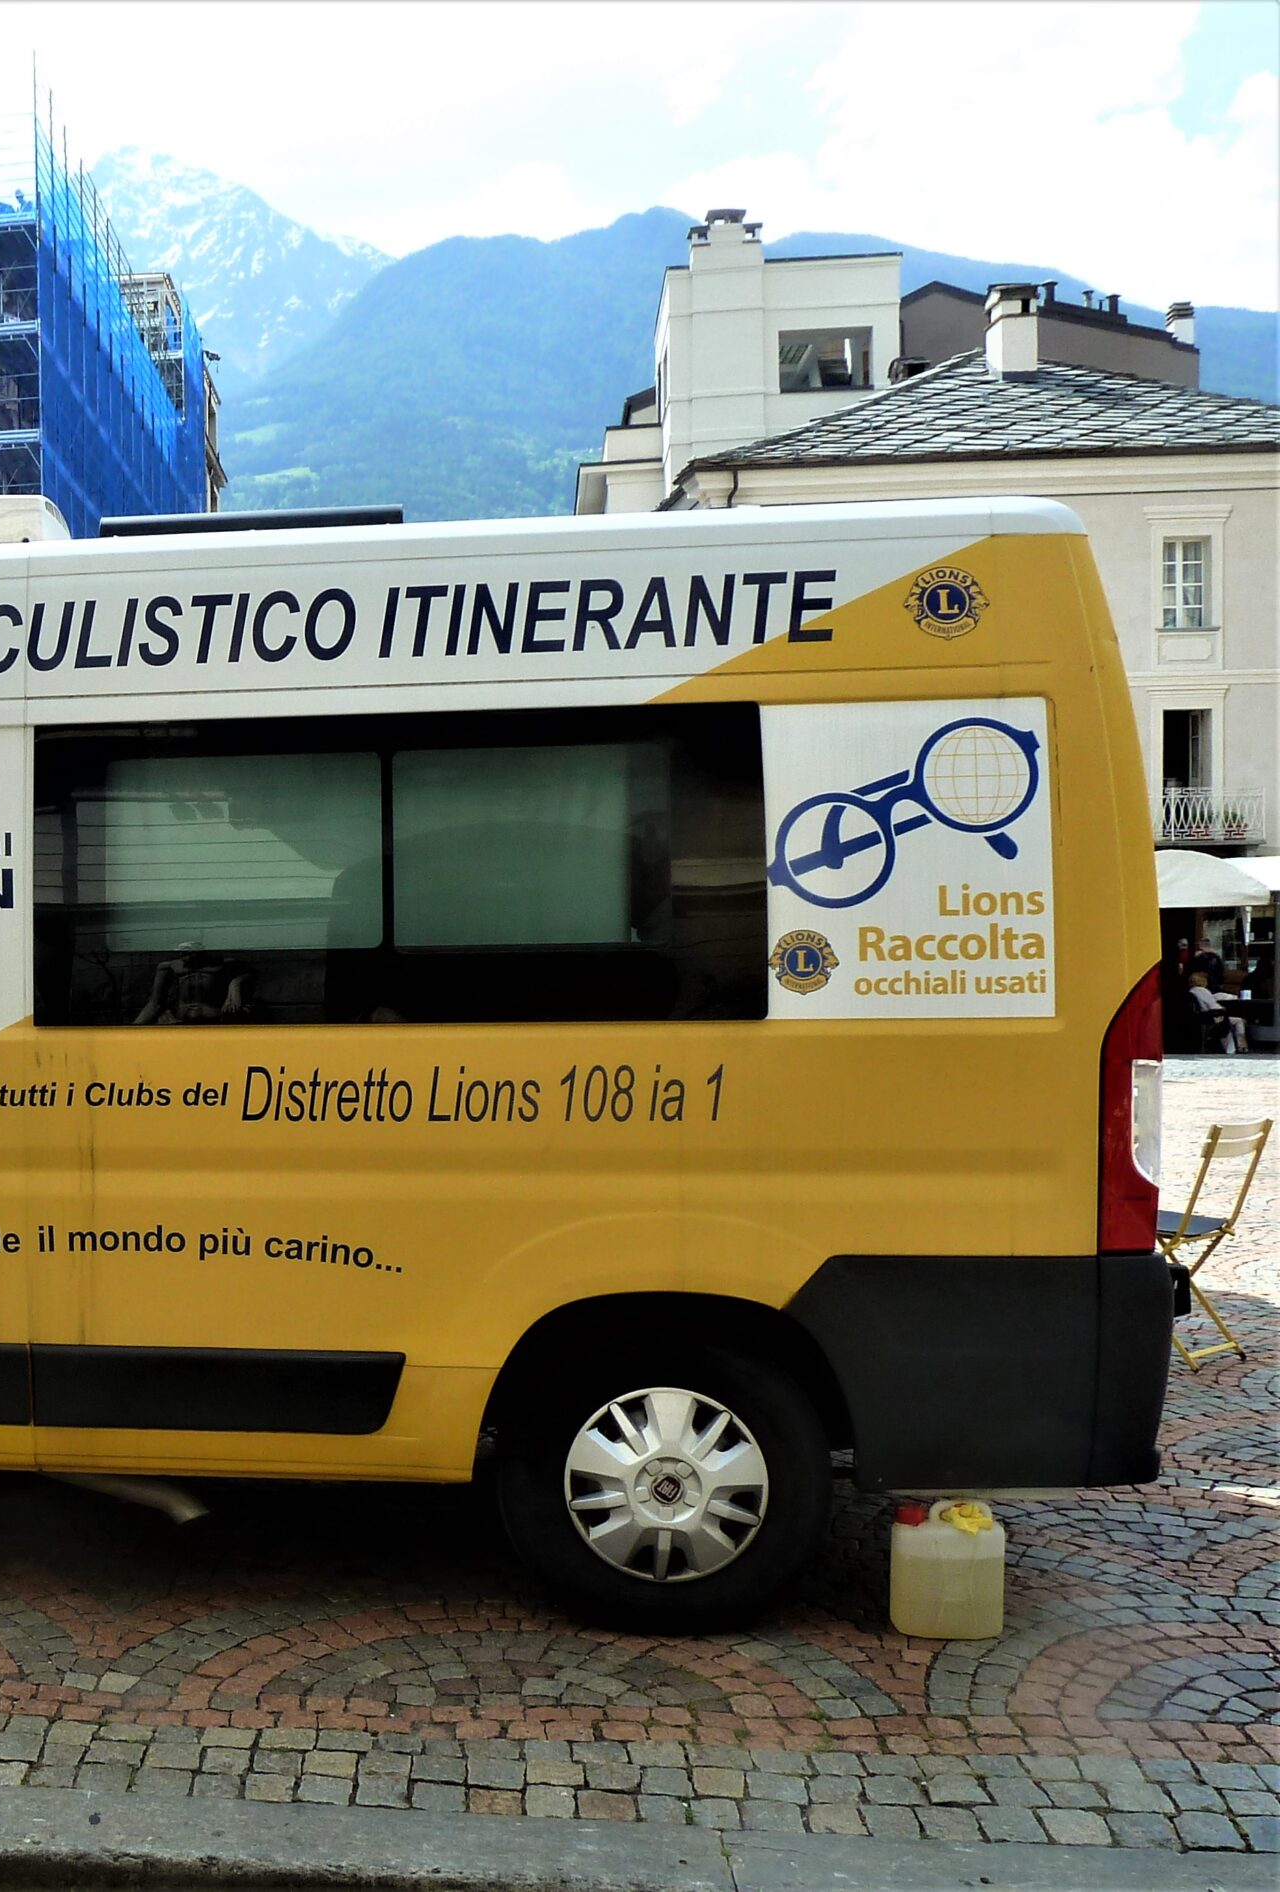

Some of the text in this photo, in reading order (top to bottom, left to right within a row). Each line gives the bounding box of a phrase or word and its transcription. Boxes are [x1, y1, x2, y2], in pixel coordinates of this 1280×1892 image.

[921, 569, 970, 585] LIONS
[378, 569, 837, 659] ITINERANTE
[937, 589, 960, 614] L
[938, 883, 1045, 917] Lions
[783, 932, 824, 946] LIONS
[858, 922, 1046, 962] Raccolta
[795, 950, 814, 972] L
[853, 970, 967, 996] occhiali
[975, 970, 1047, 994] usati
[66, 1082, 75, 1107] i
[84, 1081, 172, 1107] Clubs
[182, 1082, 229, 1107] del
[241, 1066, 413, 1123] Distretto
[427, 1065, 541, 1123] Lions
[560, 1064, 635, 1123] 108
[649, 1064, 685, 1122] ia
[706, 1063, 724, 1122] 1
[38, 1225, 55, 1253] il
[68, 1224, 186, 1253] mondo
[199, 1227, 251, 1261] più
[264, 1234, 402, 1273] carino...
